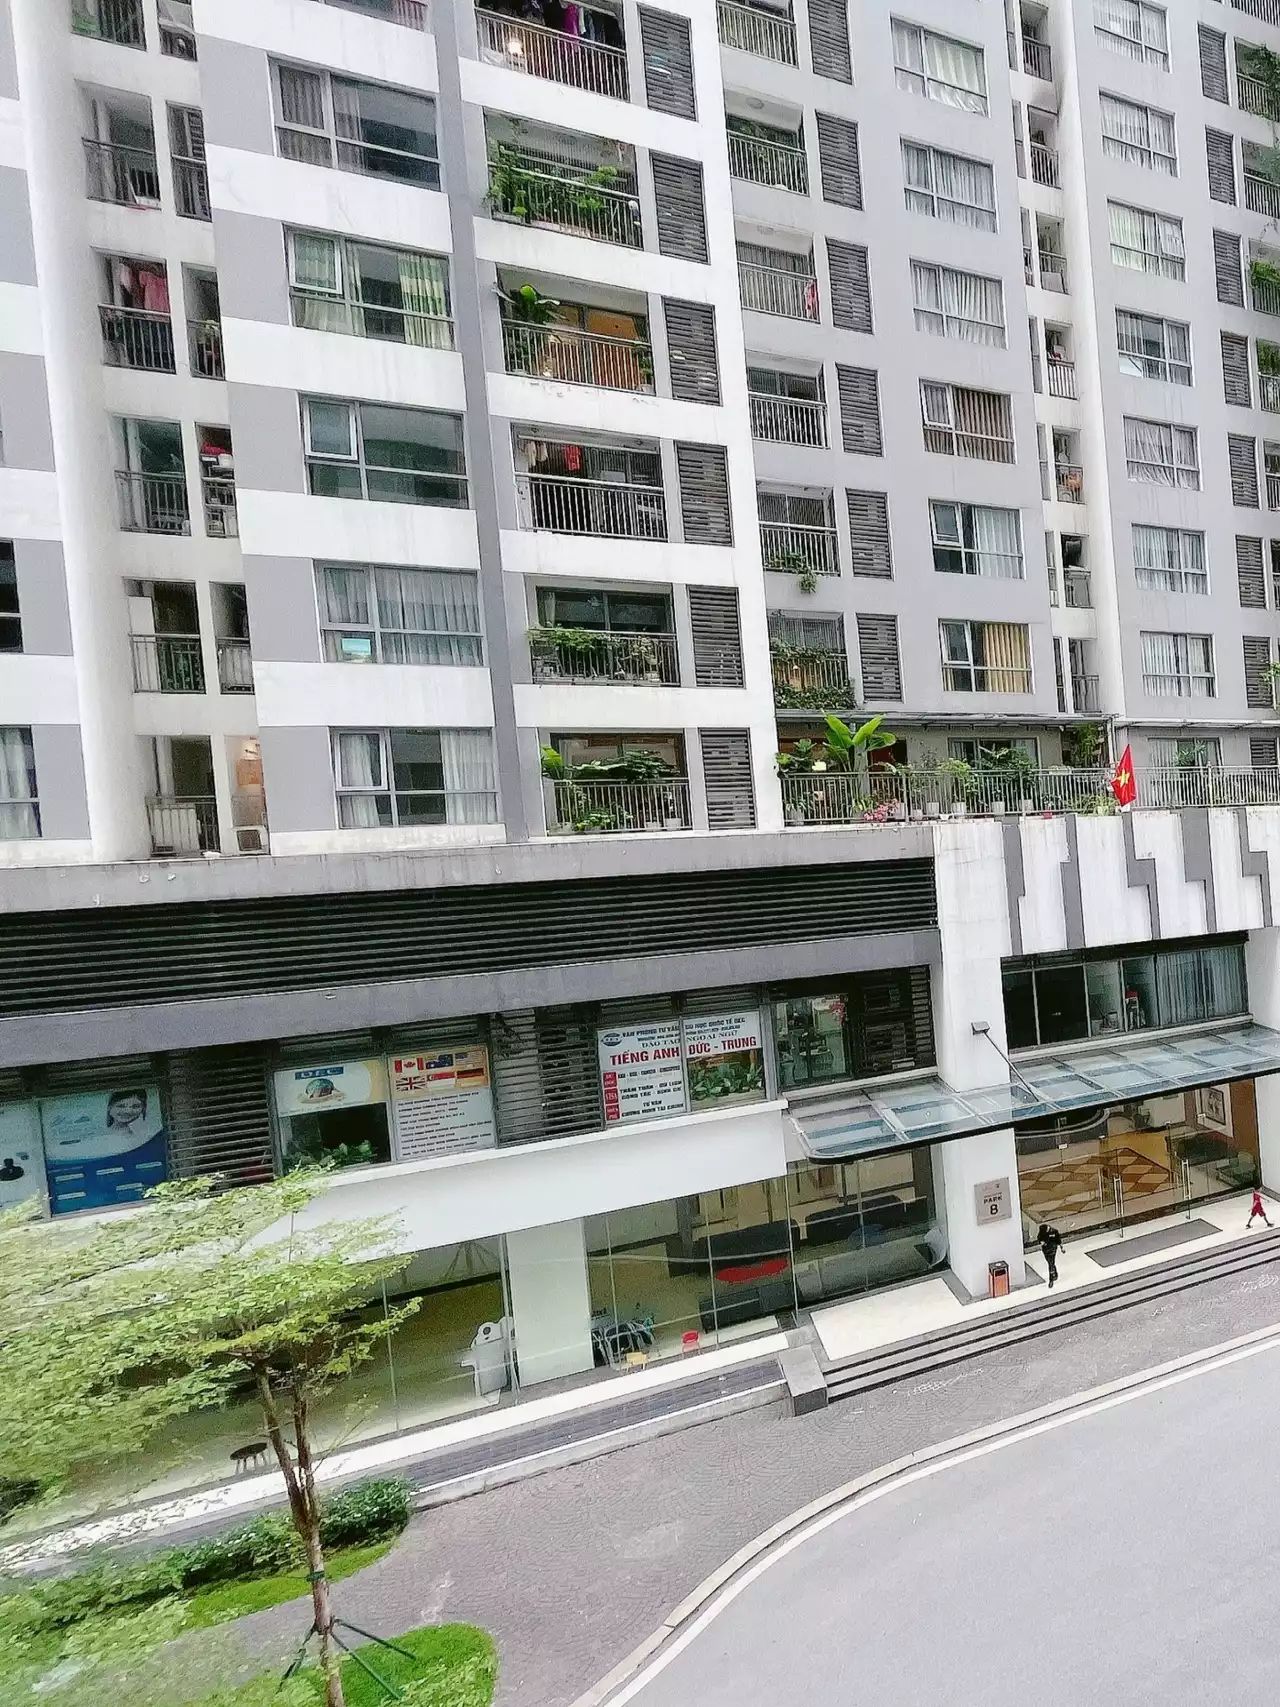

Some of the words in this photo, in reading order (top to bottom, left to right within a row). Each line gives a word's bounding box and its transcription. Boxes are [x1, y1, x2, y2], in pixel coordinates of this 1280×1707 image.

[610, 1049, 648, 1066] TIẾNG
[653, 1048, 680, 1061] ANH
[688, 1040, 711, 1055] ĐỨC
[721, 1036, 757, 1051] TRUNG
